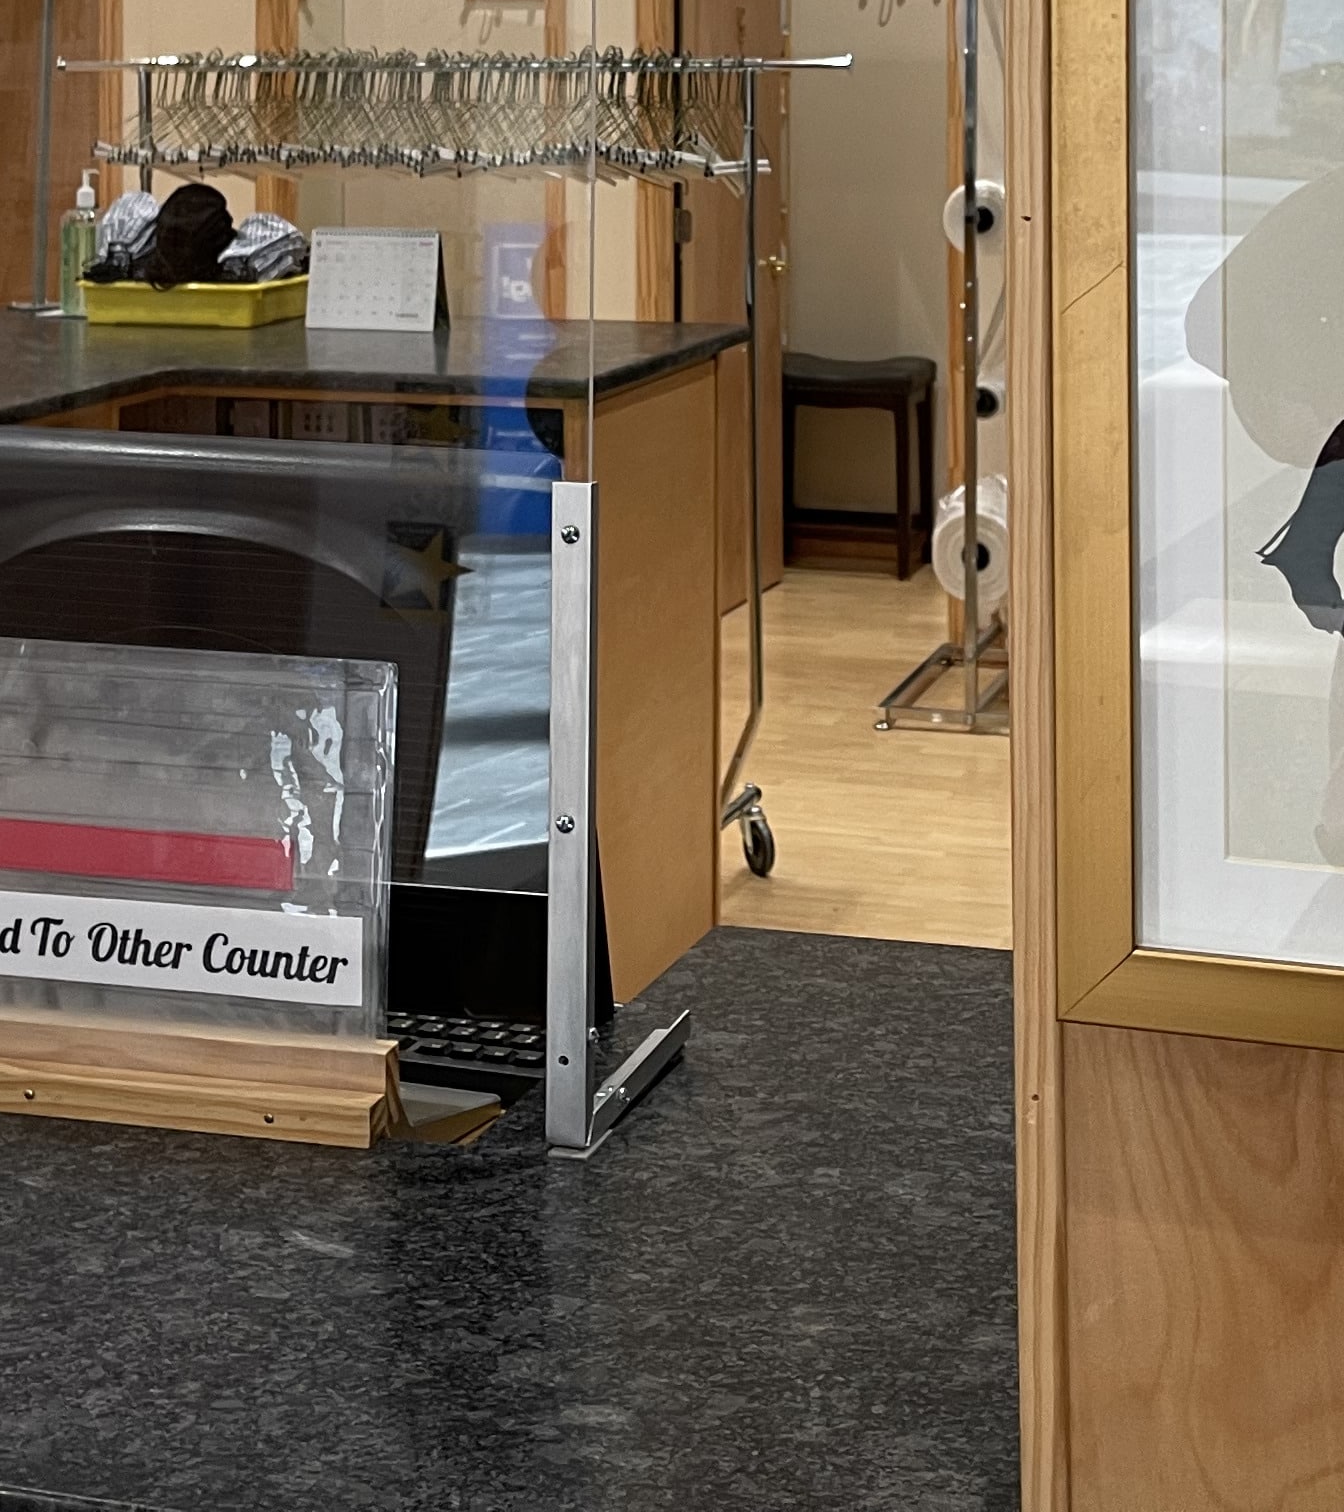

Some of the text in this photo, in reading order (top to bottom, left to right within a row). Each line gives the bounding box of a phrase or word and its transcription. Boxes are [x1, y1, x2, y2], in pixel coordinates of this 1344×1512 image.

[30, 917, 76, 958] To
[87, 922, 193, 969] Other
[202, 932, 349, 984] Counter
